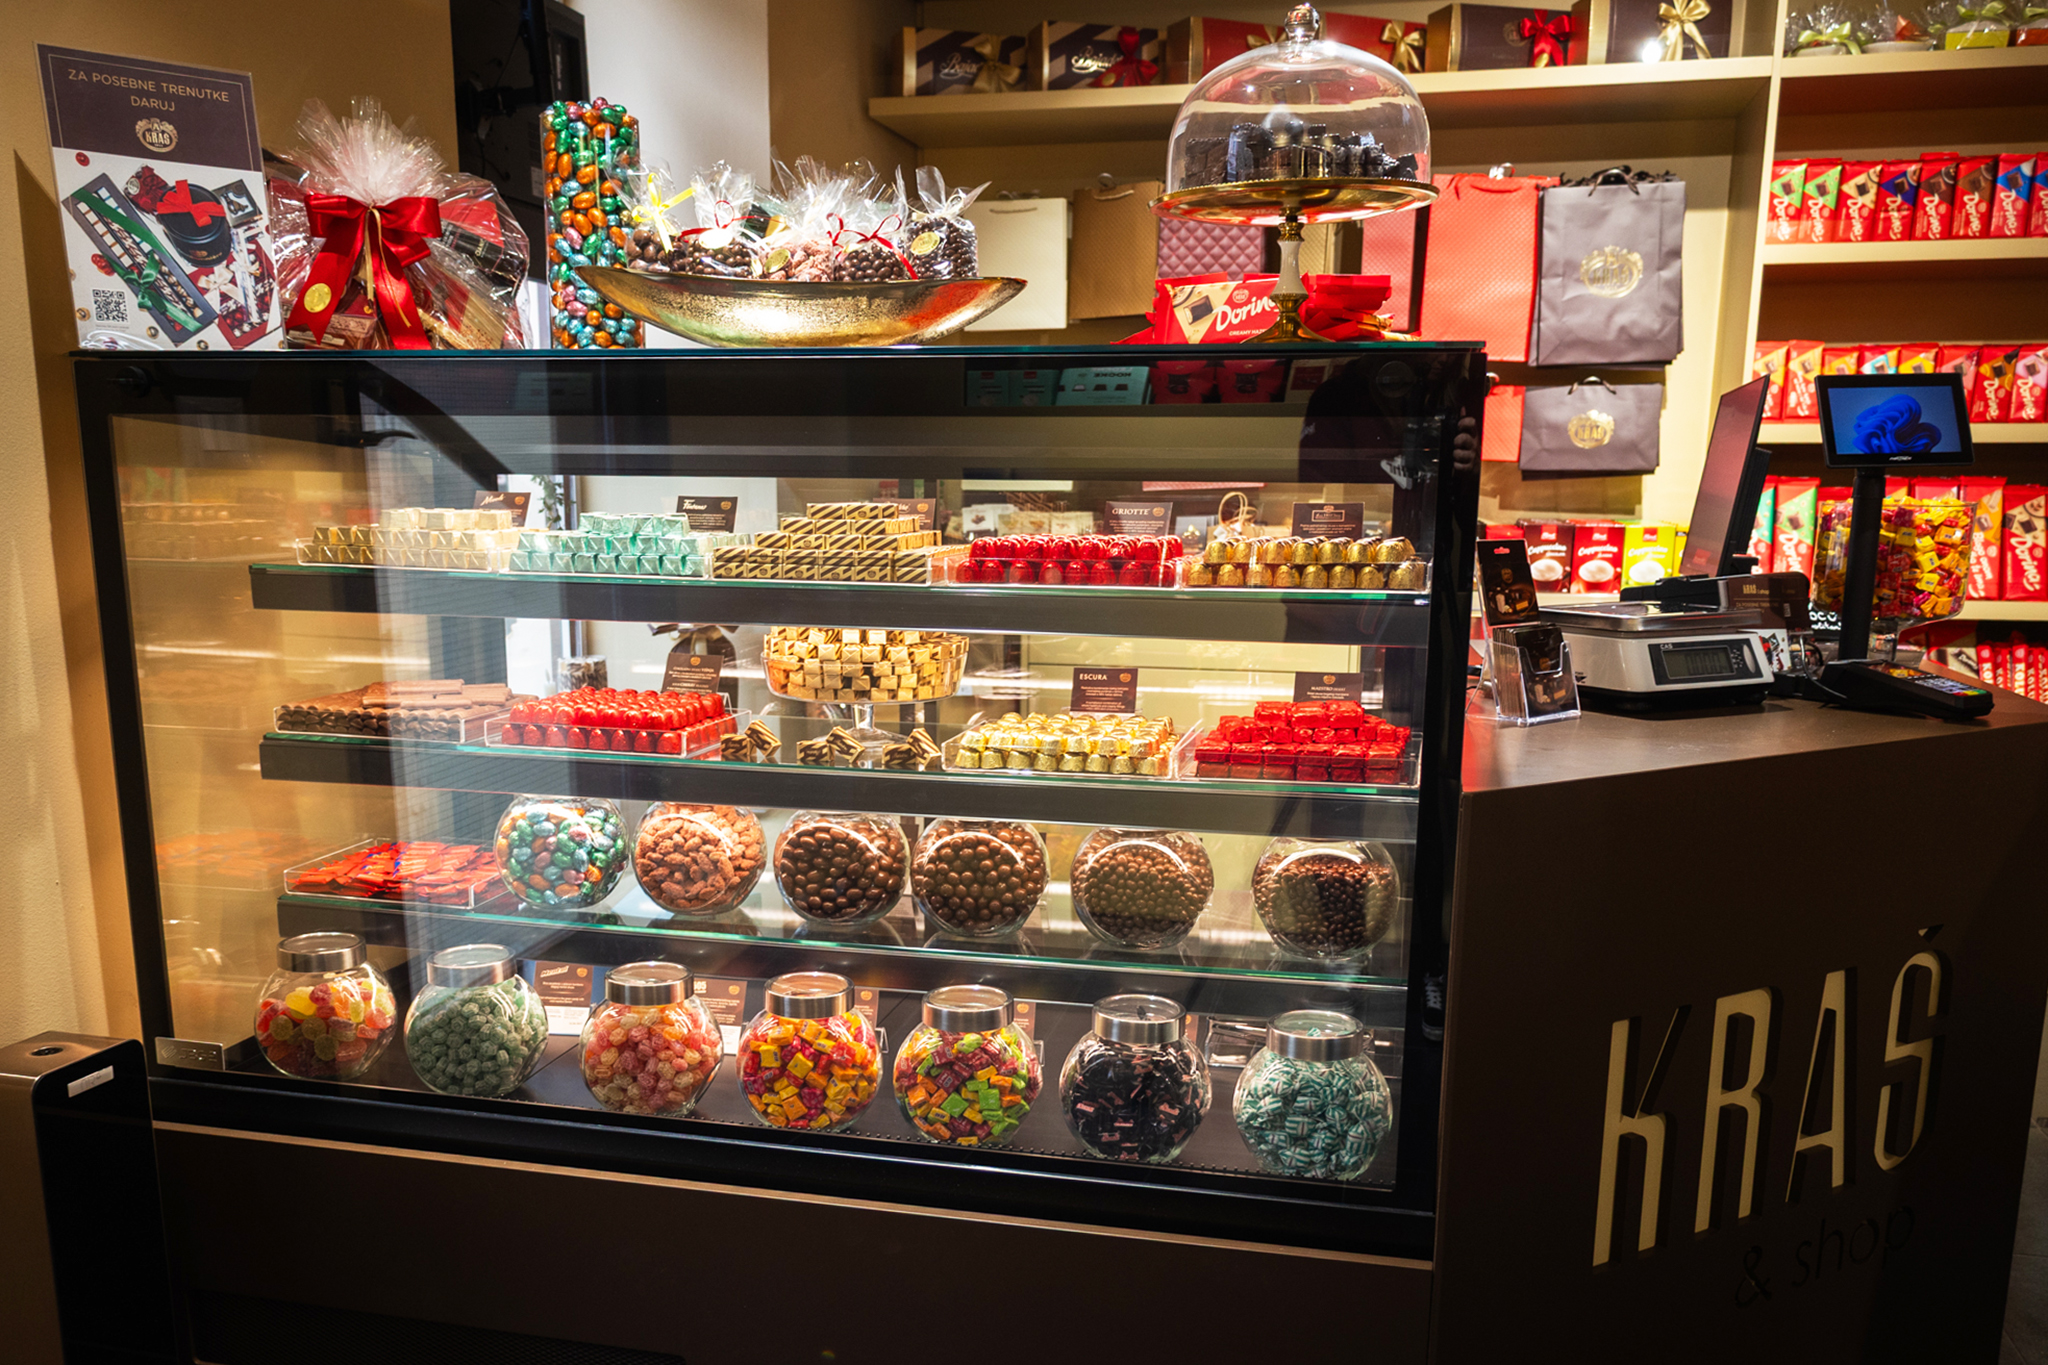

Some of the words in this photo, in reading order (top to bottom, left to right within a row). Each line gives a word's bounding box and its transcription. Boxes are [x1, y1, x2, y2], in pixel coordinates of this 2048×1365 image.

[68, 68, 88, 82] ZA
[92, 72, 157, 92] POSEBNE
[160, 82, 230, 102] TRENUTKE
[130, 95, 176, 112] DARUJ
[1983, 376, 2000, 421] Dorina
[2017, 375, 2036, 420] Dorina
[1111, 507, 1151, 516] GRIOTTE
[1778, 530, 1804, 573] Dorin
[2010, 534, 2041, 592] Dorina
[1079, 673, 1108, 681] ESCURA
[1592, 923, 1946, 1268] KRAŠ
[1734, 1244, 1772, 1309] &
[1791, 1205, 1916, 1288] shop
